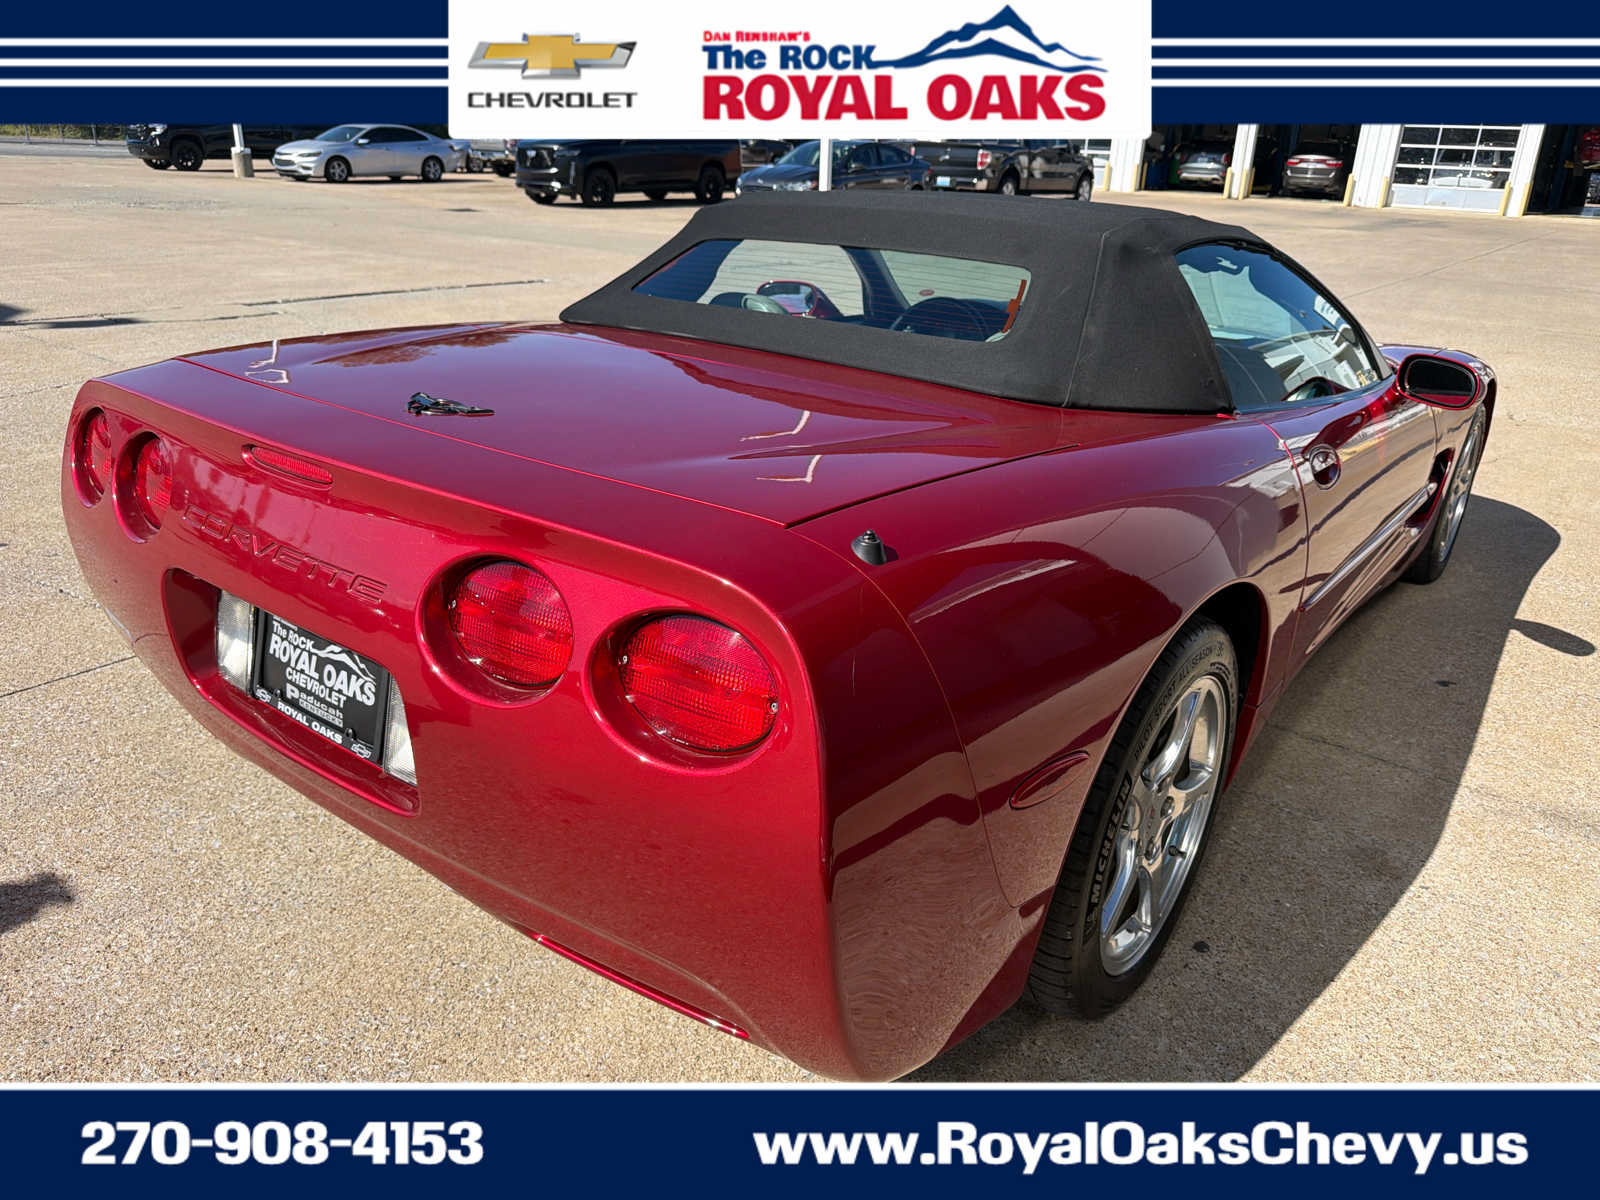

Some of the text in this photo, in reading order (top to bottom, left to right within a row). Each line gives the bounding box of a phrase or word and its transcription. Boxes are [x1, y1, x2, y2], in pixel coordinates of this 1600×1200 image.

[181, 503, 388, 604] CORVETTE
[272, 620, 287, 638] The
[288, 629, 314, 651] ROCK
[269, 632, 377, 707] ROYAL OAKS
[285, 666, 347, 708] CHEVROLET
[285, 682, 344, 719] Paducah
[277, 701, 343, 745] ROYAL OAKS
[1091, 778, 1131, 904] MICHELIN
